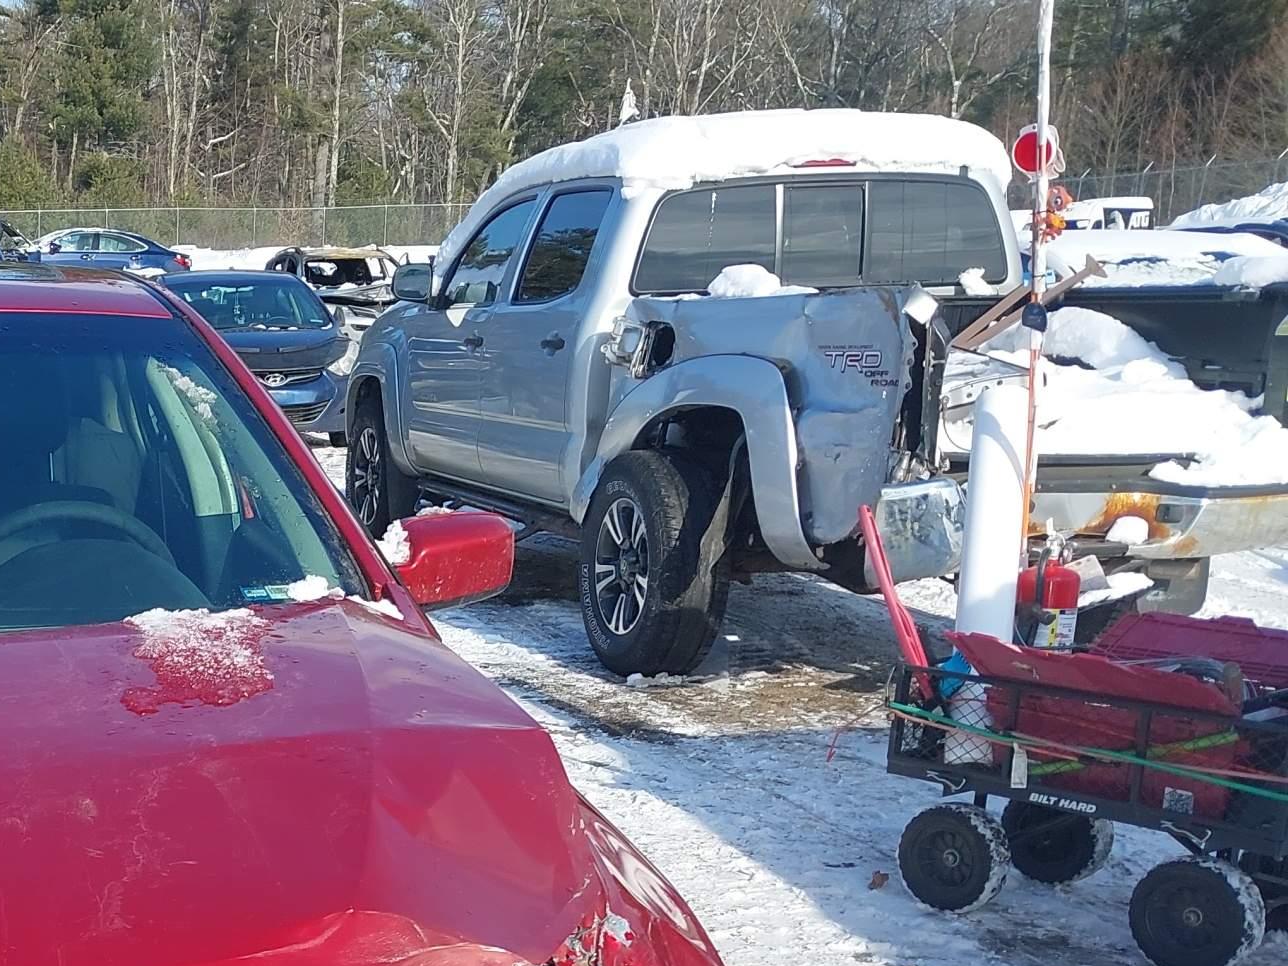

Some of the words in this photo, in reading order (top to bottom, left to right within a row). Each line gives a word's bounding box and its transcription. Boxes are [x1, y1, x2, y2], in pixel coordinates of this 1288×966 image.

[825, 351, 881, 373] TRD
[864, 370, 889, 378] OFF
[1029, 792, 1056, 805] BILT
[1059, 798, 1097, 813] HARD
